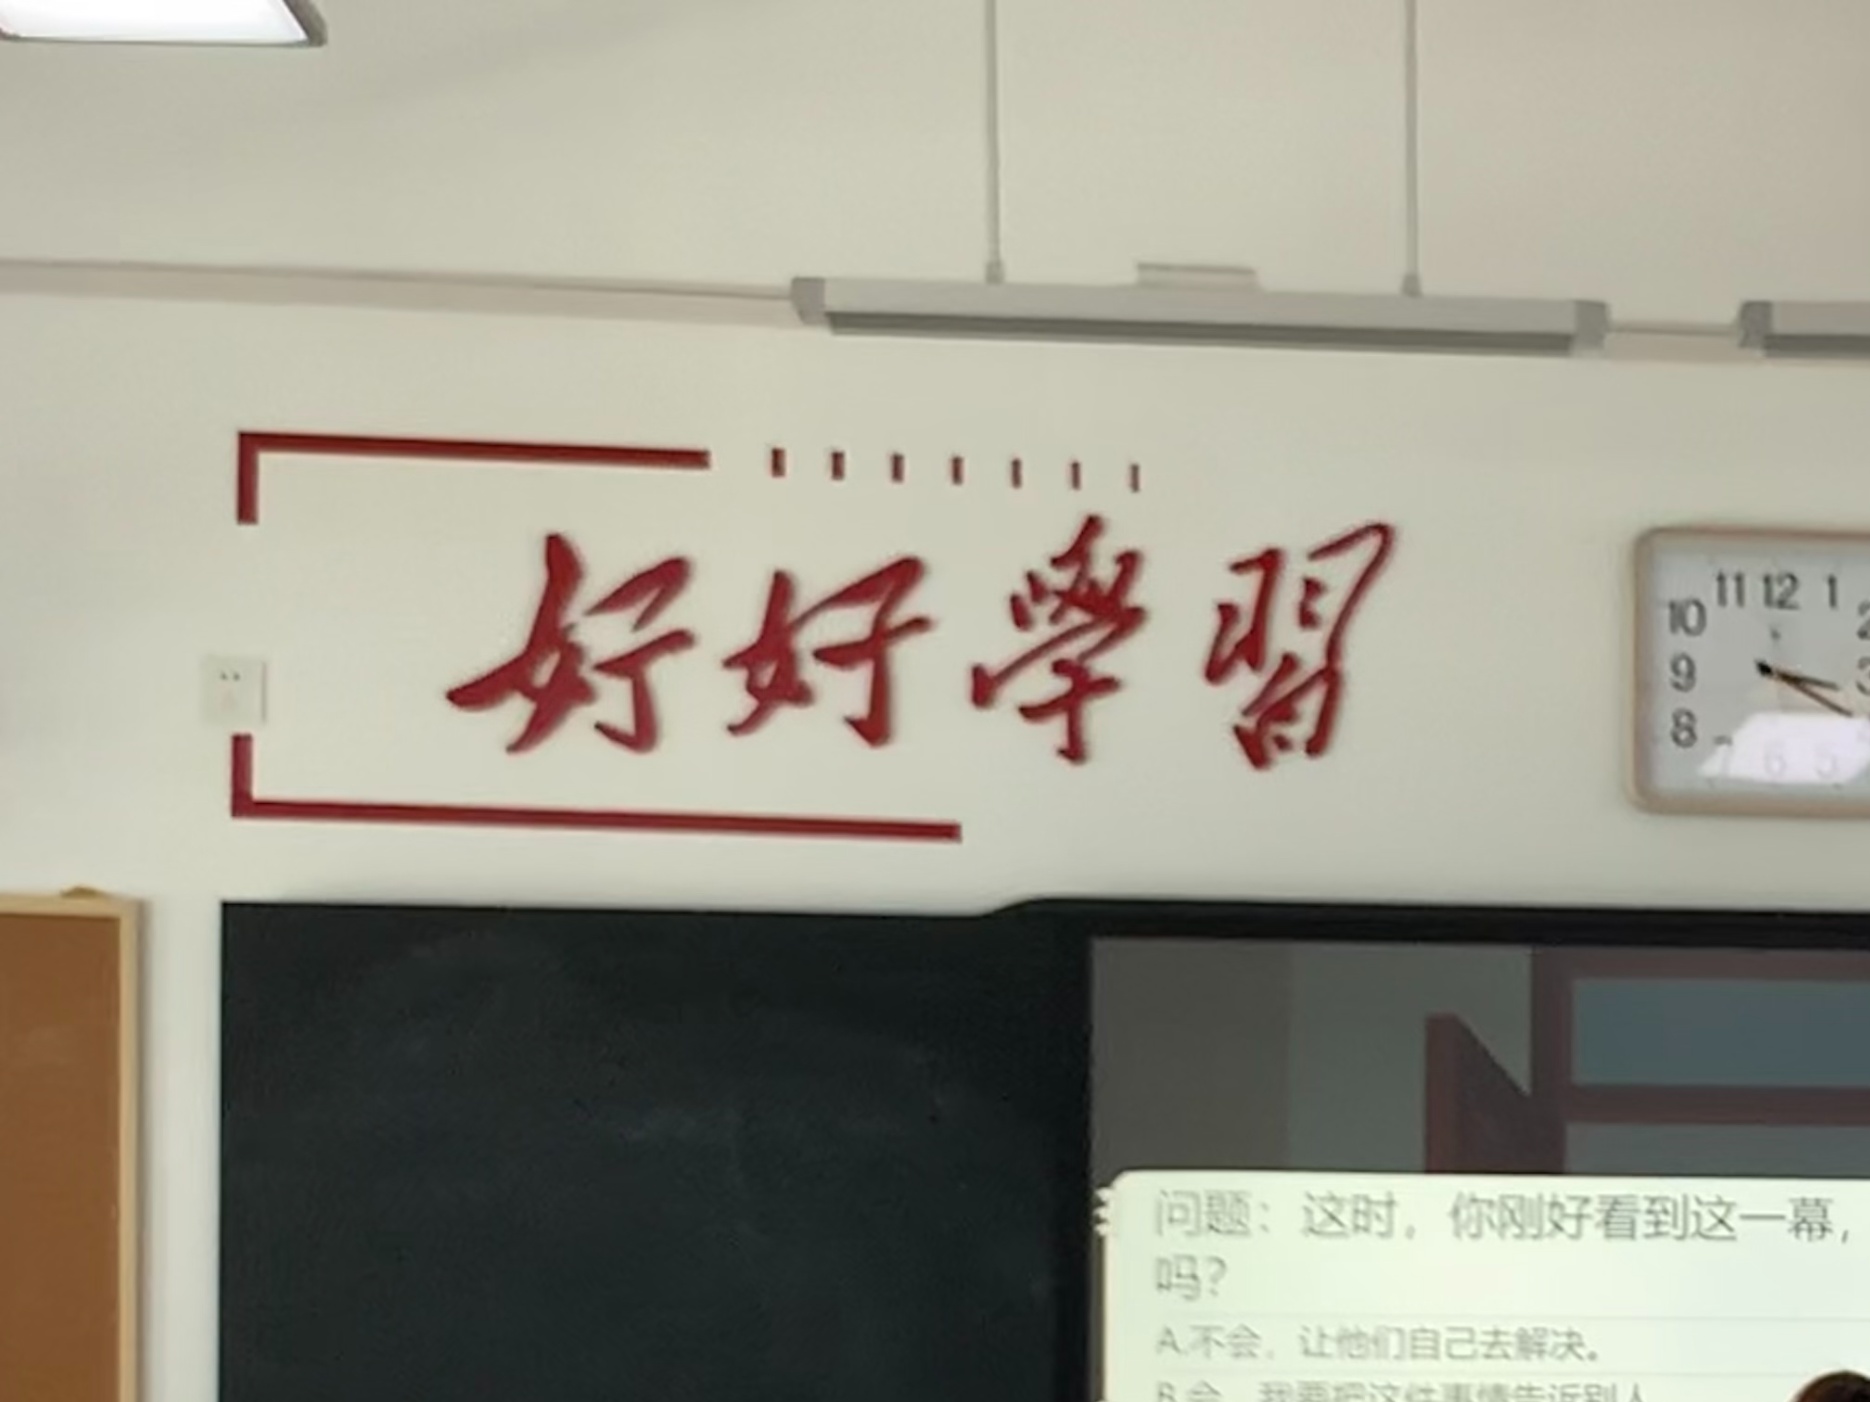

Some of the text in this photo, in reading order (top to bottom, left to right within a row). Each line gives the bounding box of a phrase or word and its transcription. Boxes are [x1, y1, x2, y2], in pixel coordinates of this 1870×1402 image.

[1715, 570, 1746, 608] 11
[1761, 571, 1800, 610] 12
[1824, 573, 1838, 609] 1
[1667, 597, 1707, 637] 10
[1669, 652, 1697, 693] 9
[1669, 708, 1698, 749] 8
